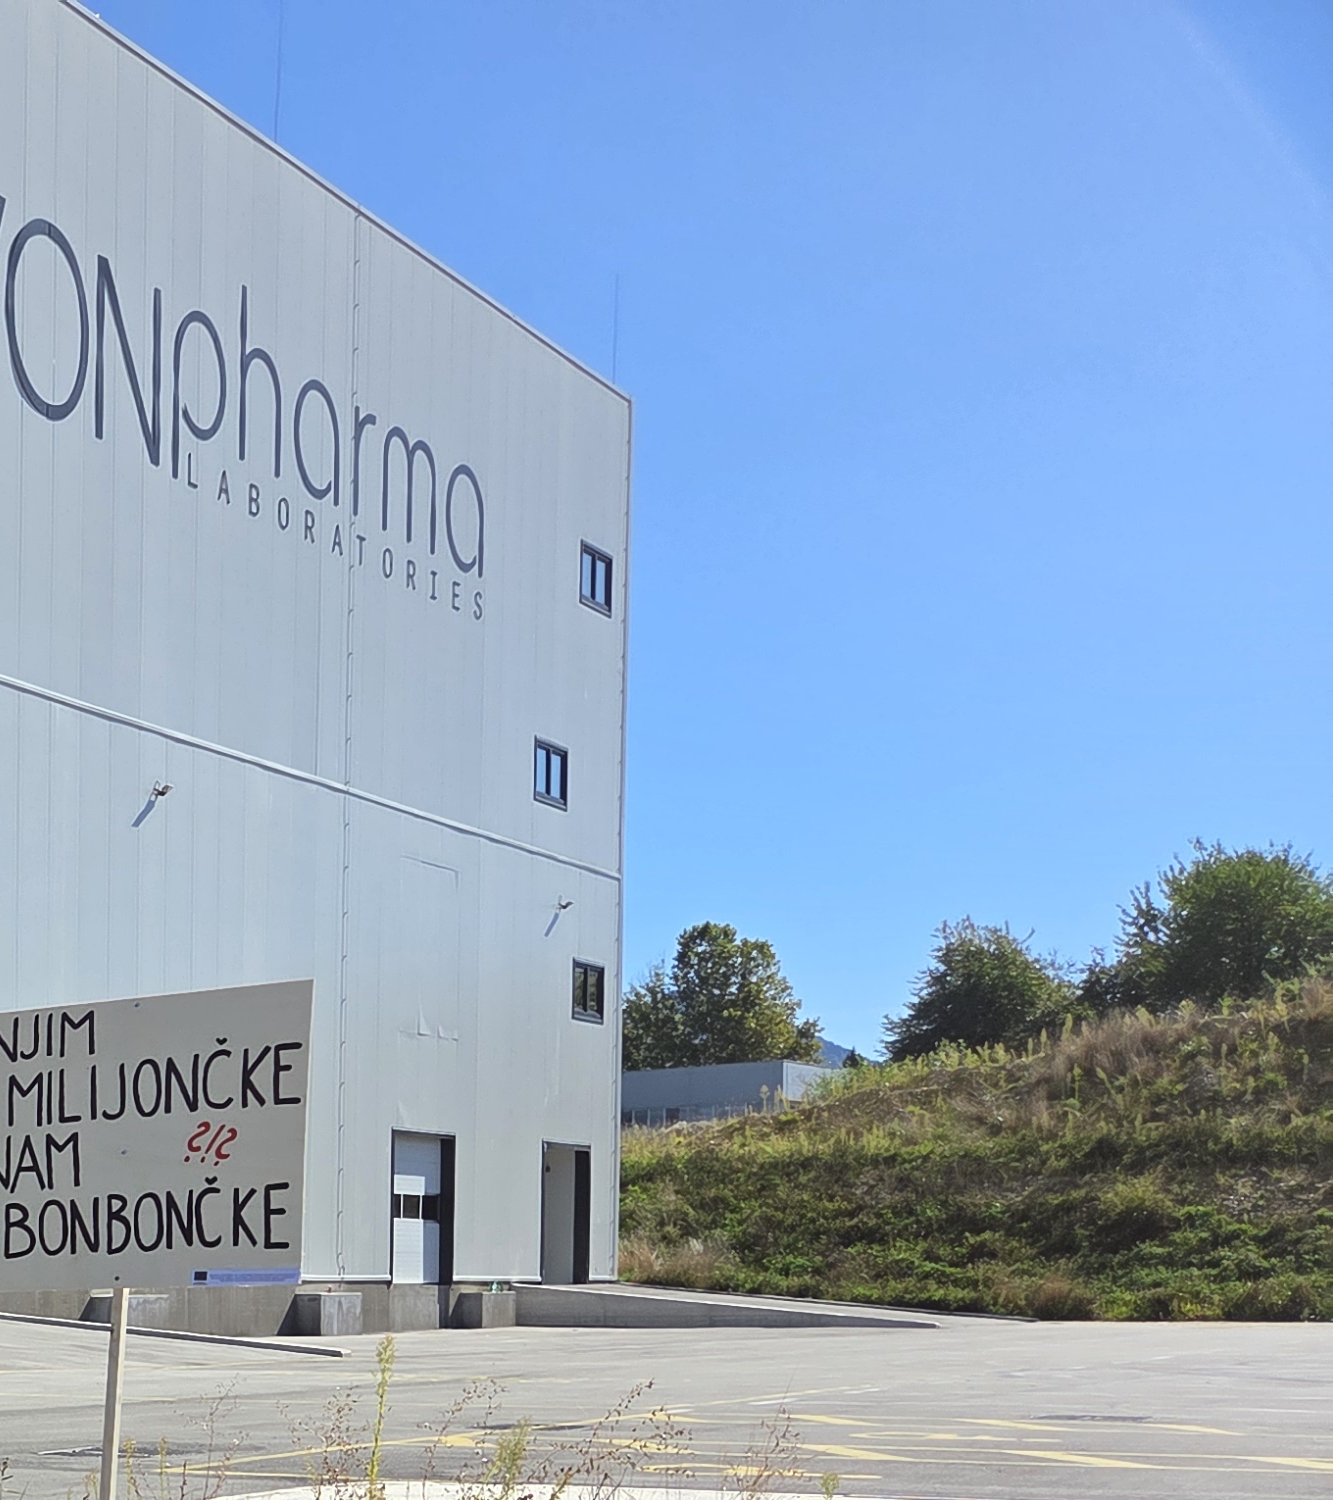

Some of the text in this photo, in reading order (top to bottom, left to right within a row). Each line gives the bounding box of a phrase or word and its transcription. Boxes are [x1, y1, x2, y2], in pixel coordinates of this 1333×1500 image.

[186, 452, 485, 621] LABORATORIES
[7, 1037, 304, 1127] MILIJONČKE
[3, 1175, 290, 1260] BONBONČKE
